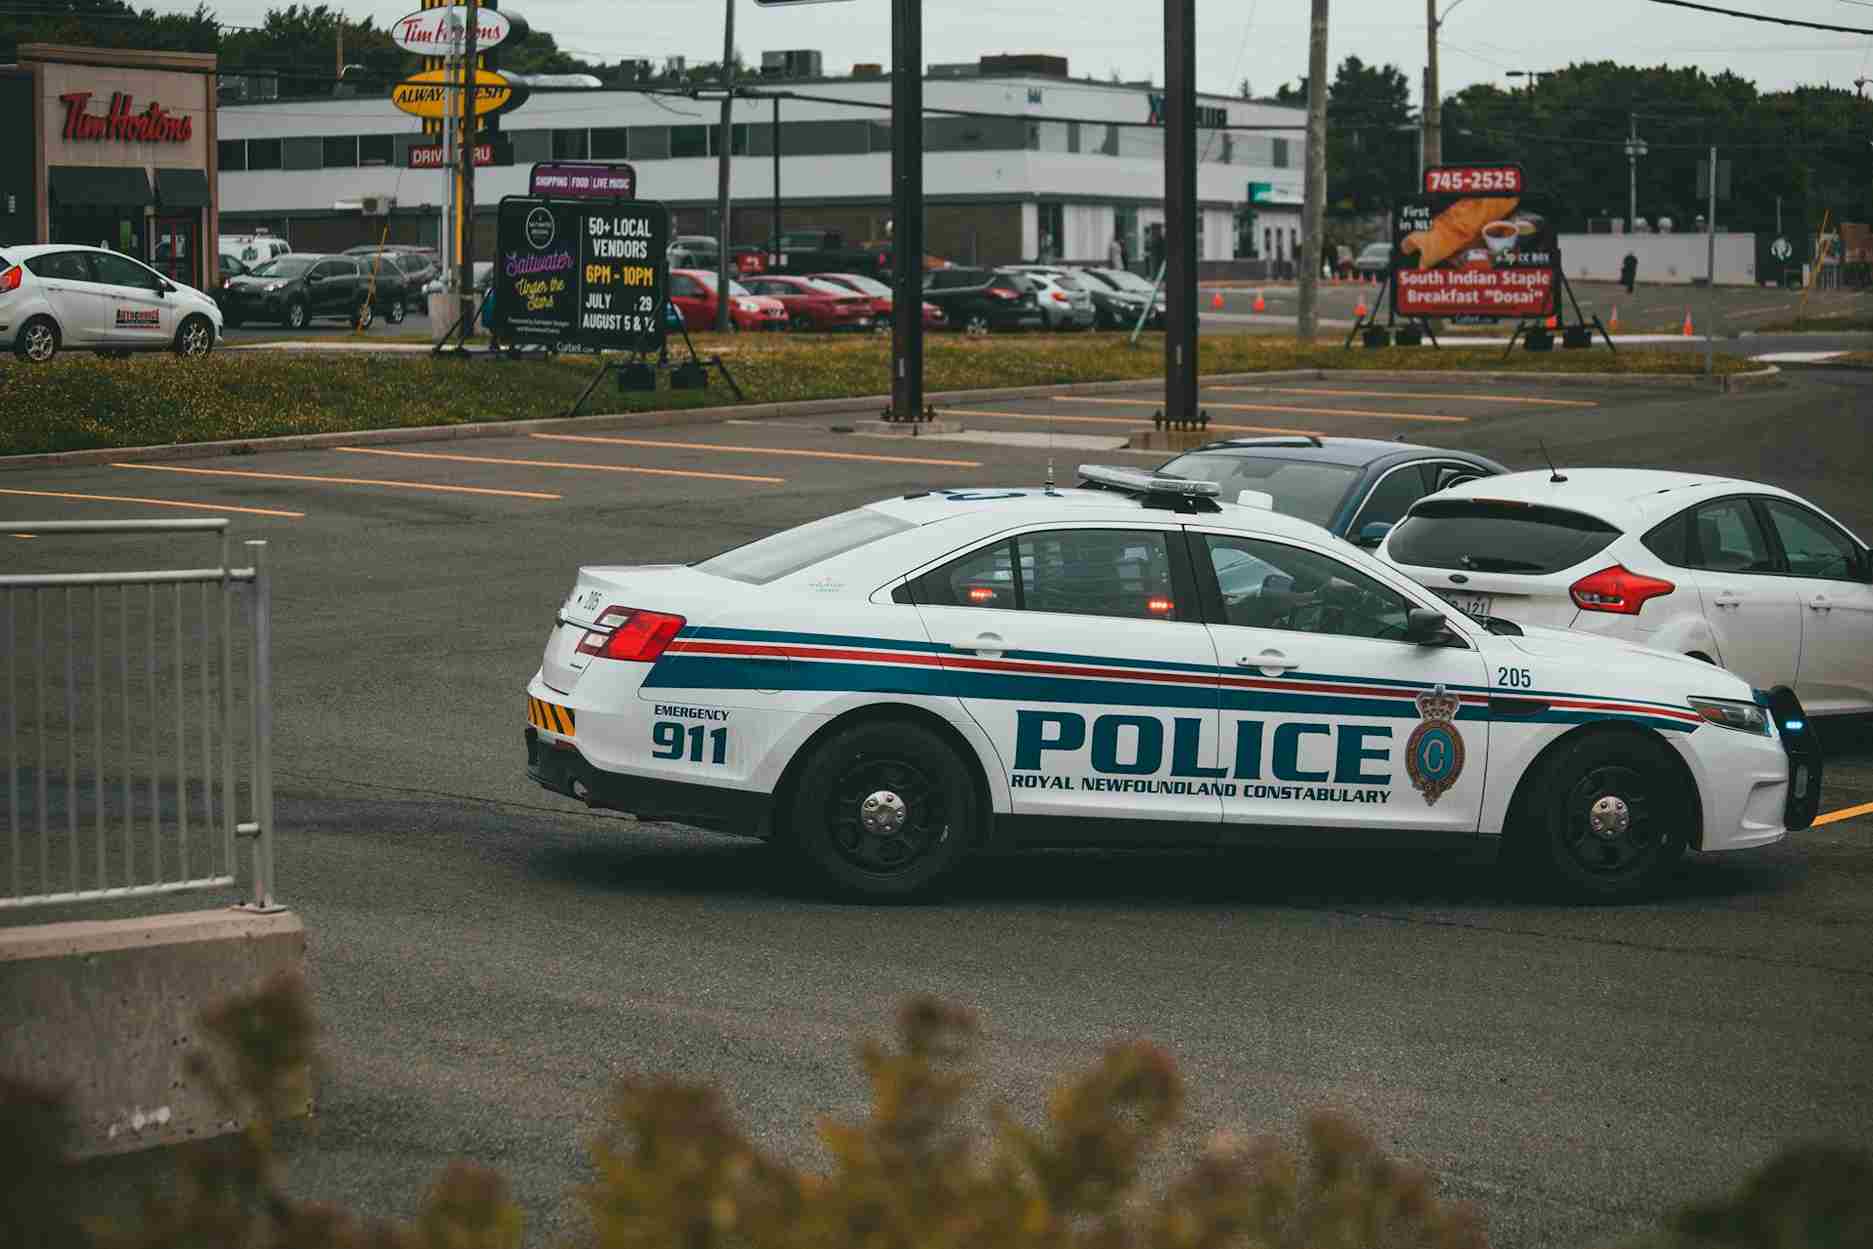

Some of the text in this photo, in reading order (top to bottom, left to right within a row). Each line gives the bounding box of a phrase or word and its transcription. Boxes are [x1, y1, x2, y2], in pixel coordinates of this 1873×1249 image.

[402, 18, 432, 44] Tim
[59, 91, 193, 142] Tim Hortons
[412, 148, 442, 163] DRIV
[571, 176, 590, 189] FOOD
[592, 177, 608, 189] LIVE
[1429, 171, 1517, 190] 745-2525
[588, 216, 653, 238] 50+ LOCAL
[593, 238, 648, 259] VENDORS
[585, 264, 611, 285] 6PM
[623, 265, 654, 288] 10PM
[1400, 270, 1550, 288] South Indian Staple
[584, 292, 653, 312] JULY 29
[1407, 289, 1480, 304] Breakfast
[582, 313, 622, 333] AUGUST
[623, 315, 631, 332] 5
[632, 316, 642, 332] &
[1498, 666, 1531, 688] 205
[655, 704, 730, 721] EMERGENCY
[652, 721, 728, 765] 911
[1012, 709, 1393, 785] POLICE
[1011, 774, 1392, 804] ROYAL NEWFOUNDLAND CONSTABULARY
